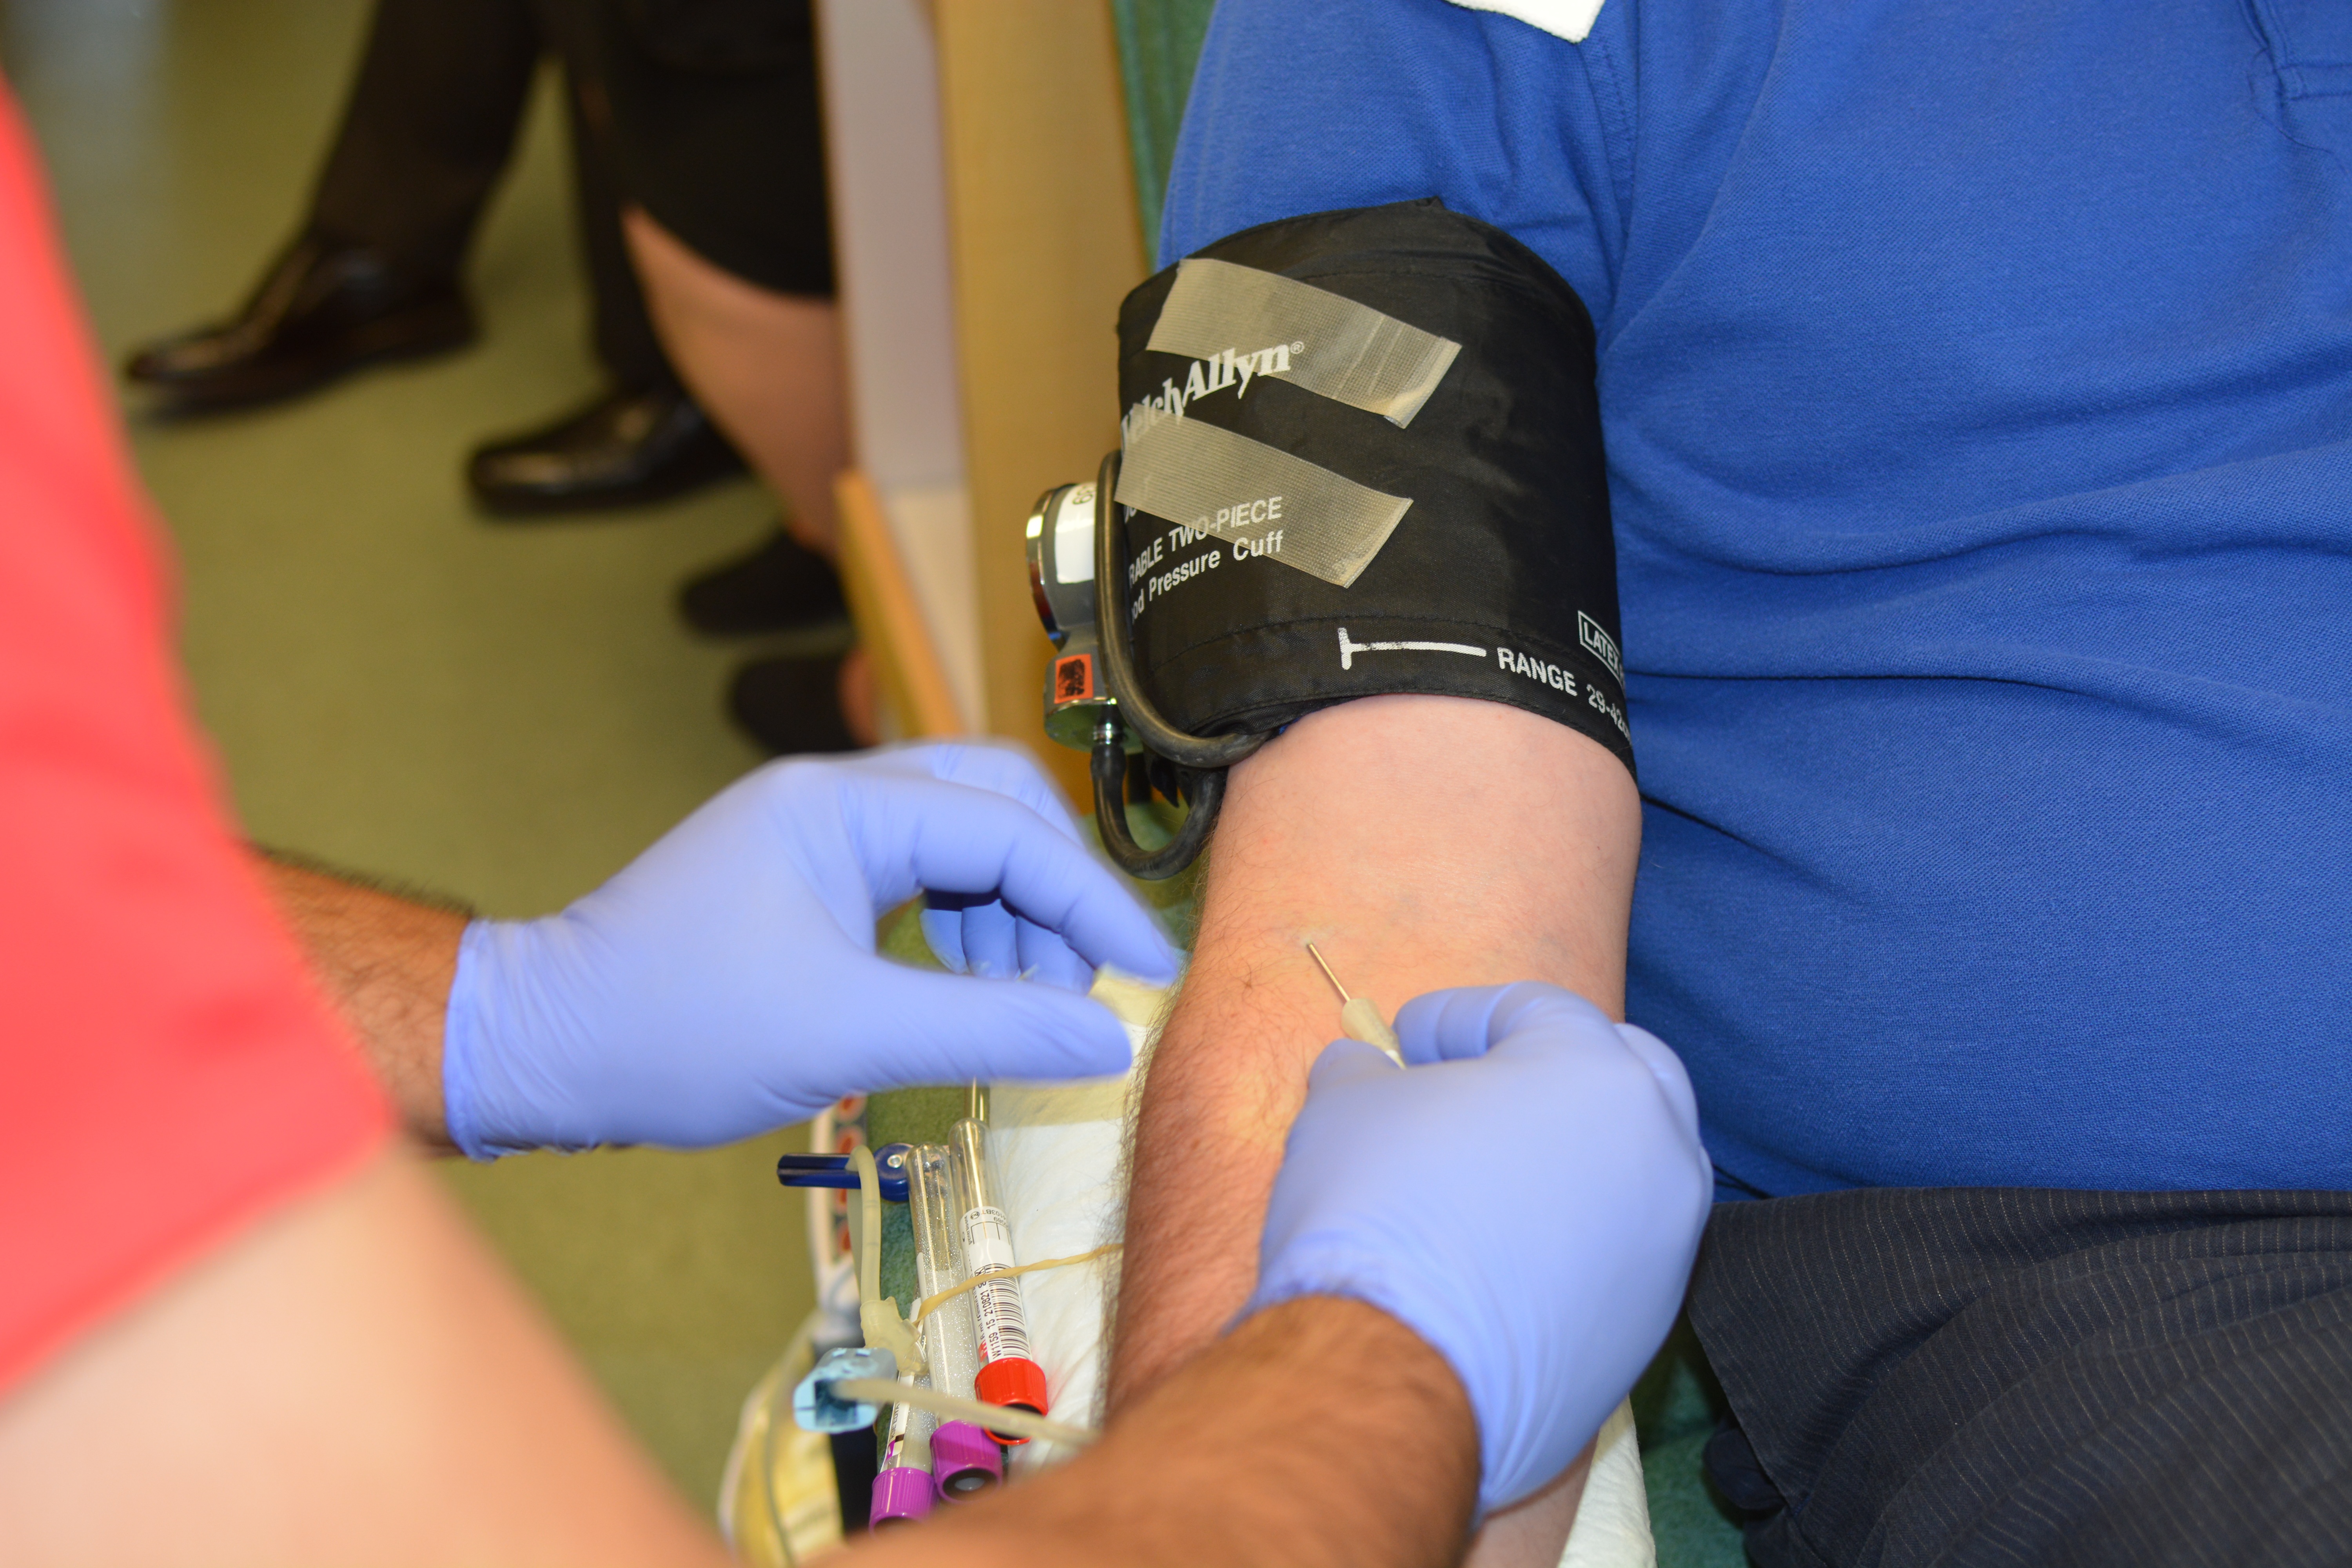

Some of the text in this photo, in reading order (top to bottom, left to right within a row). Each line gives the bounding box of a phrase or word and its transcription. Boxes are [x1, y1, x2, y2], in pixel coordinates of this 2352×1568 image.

[1169, 496, 1282, 552] TWO-PIECE
[1149, 550, 1221, 601] Pressure
[1233, 530, 1283, 561] Cuff
[1497, 646, 1577, 697] RANGE
[1584, 621, 1619, 674] LATEX
[980, 1289, 993, 1317] 210821
[986, 1319, 996, 1329] 15
[989, 1332, 1002, 1359] W1159
